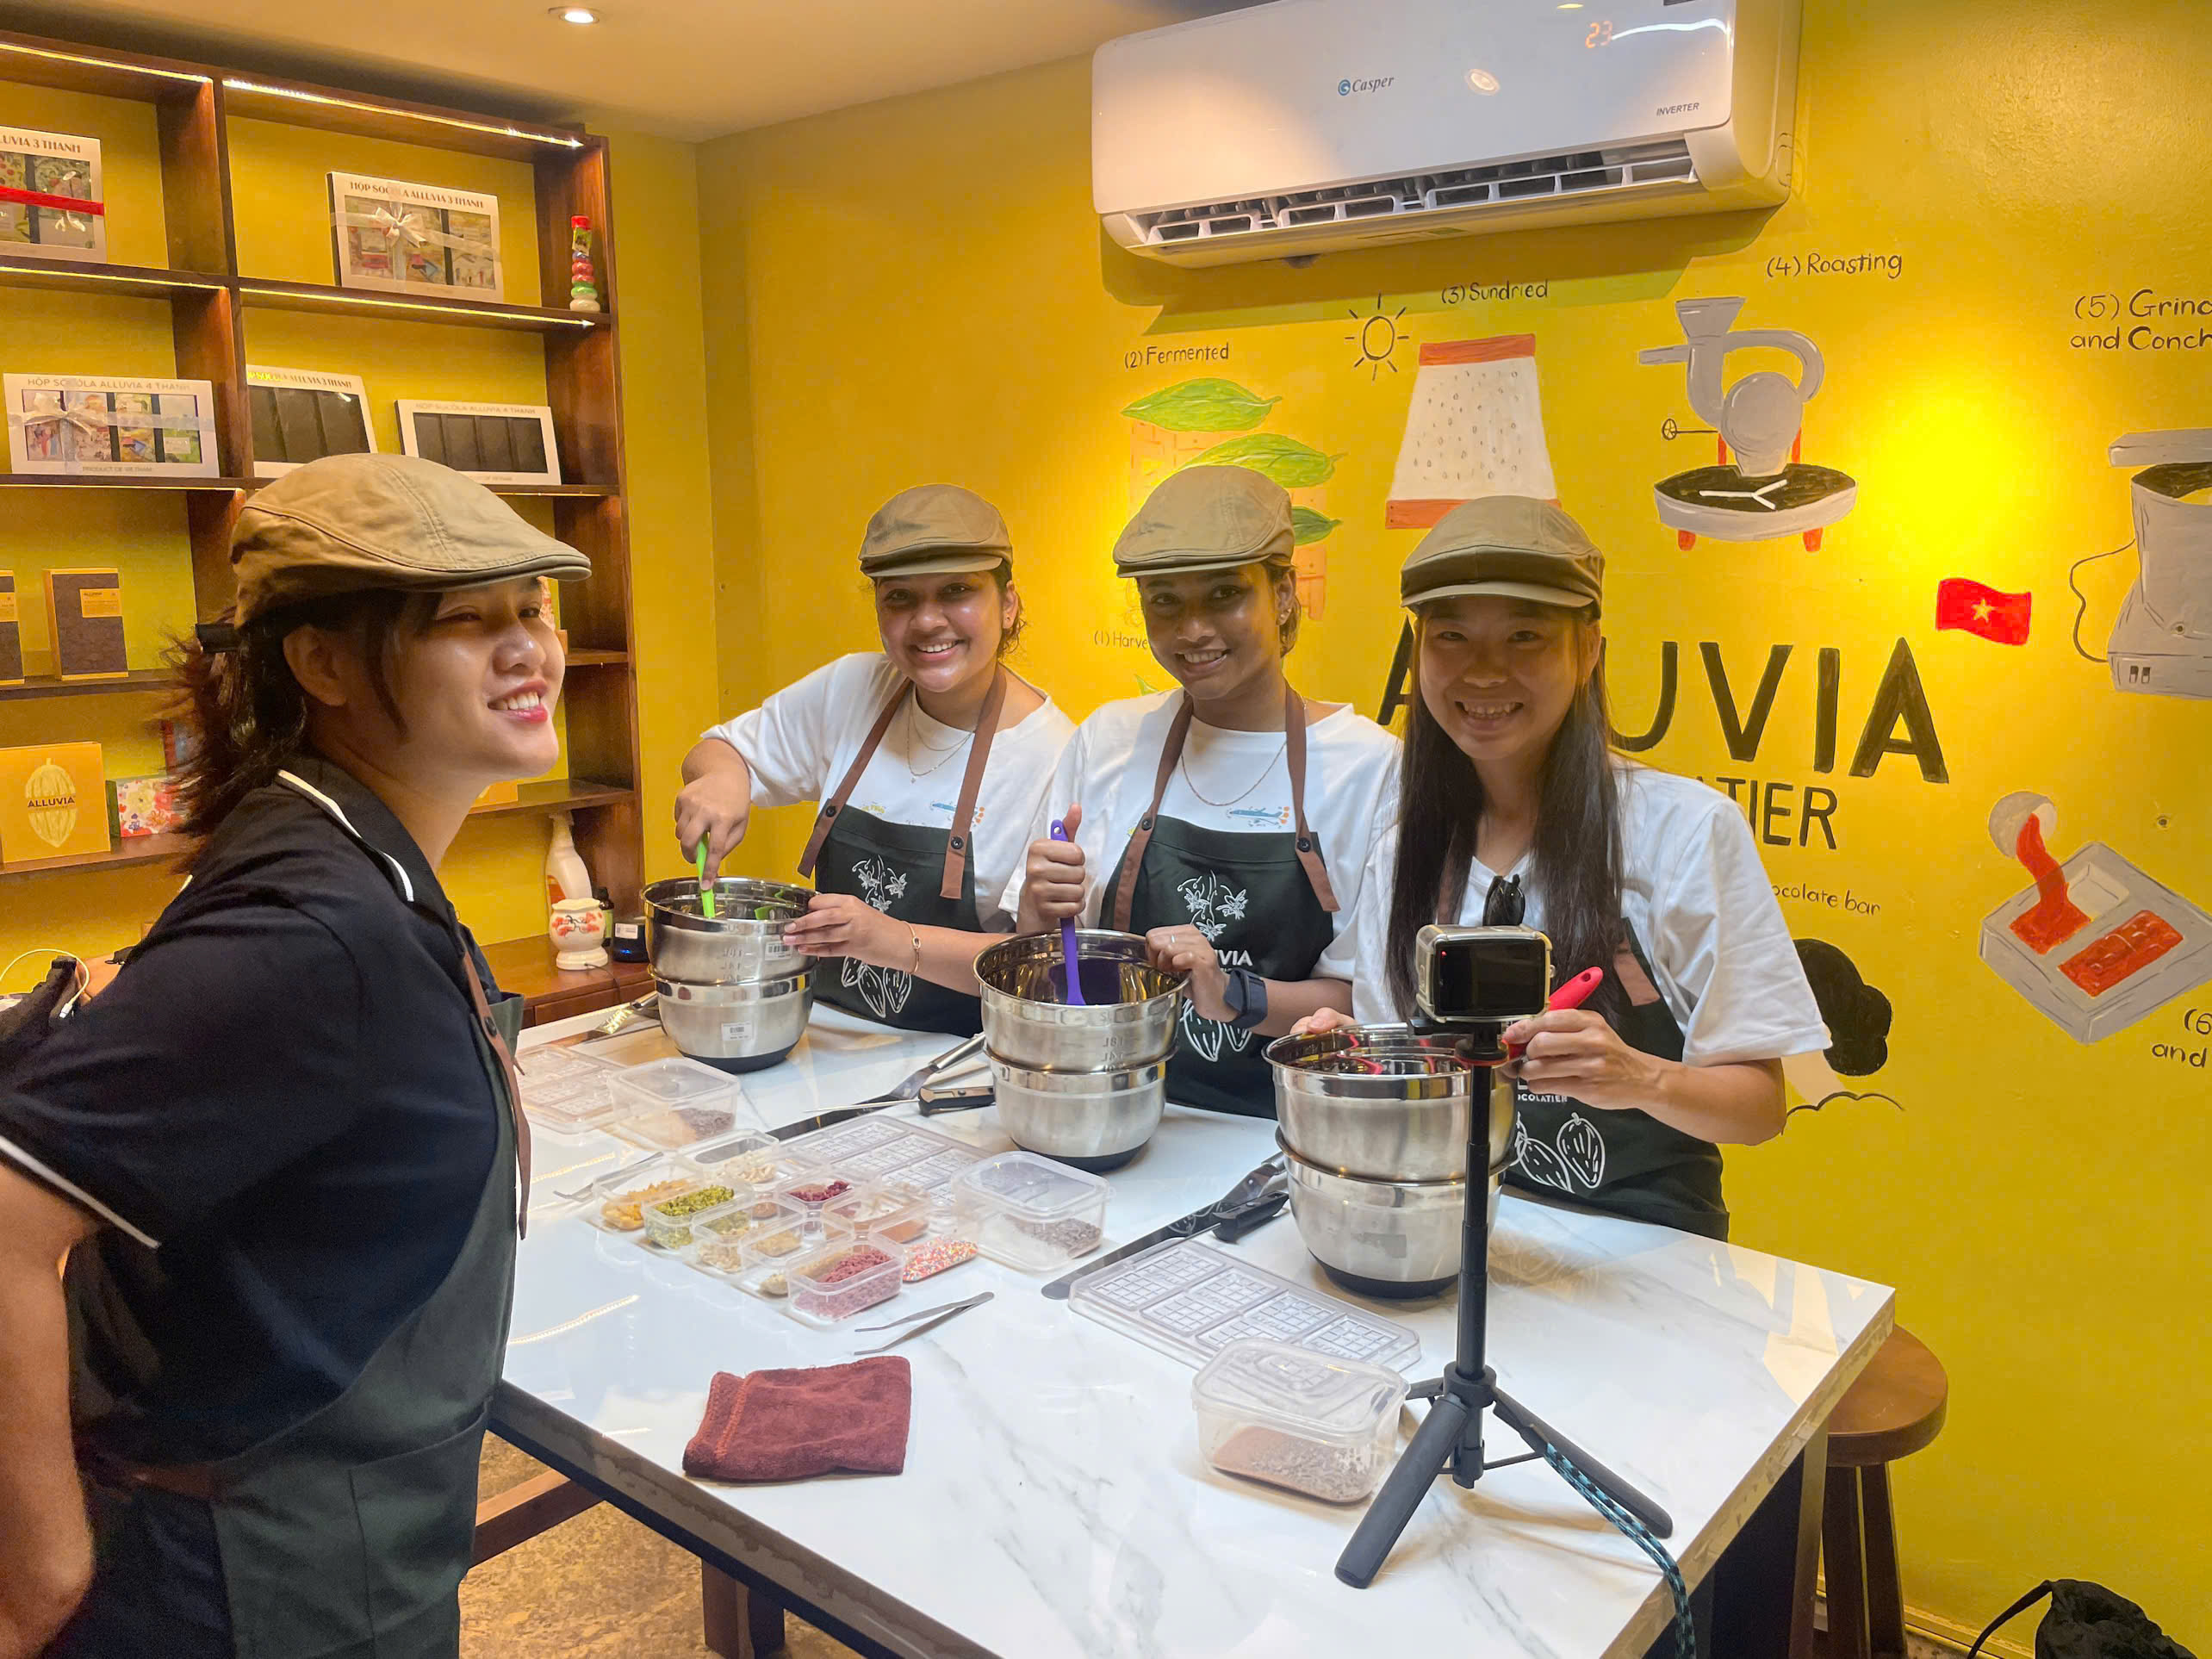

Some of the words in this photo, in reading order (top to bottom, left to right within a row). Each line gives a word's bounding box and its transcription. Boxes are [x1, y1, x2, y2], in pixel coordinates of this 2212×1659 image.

[1585, 20, 1613, 49] 23
[1351, 77, 1395, 93] Casper
[1656, 102, 1699, 116] INVERTER
[0, 134, 30, 146] UVIA
[33, 139, 40, 148] 3
[42, 140, 81, 153] THANH
[411, 190, 446, 202] ALLUVIA
[447, 195, 453, 204] 3
[455, 197, 483, 208] THANH
[1767, 255, 1801, 278] (4)
[1807, 252, 1903, 279] Roasting
[1441, 284, 1466, 304] (3)
[1468, 278, 1549, 301] Sundried
[2074, 293, 2120, 320] (5)
[2070, 326, 2121, 350] and
[1124, 350, 1143, 369] (2)
[1146, 341, 1229, 365] Fermented
[100, 380, 143, 389] ALLUVIA
[28, 796, 75, 808] ALLUVIA
[1697, 776, 1837, 849] TIER
[1845, 890, 1881, 916] bar
[1215, 949, 1253, 966] VIA
[2152, 1043, 2208, 1068] and
